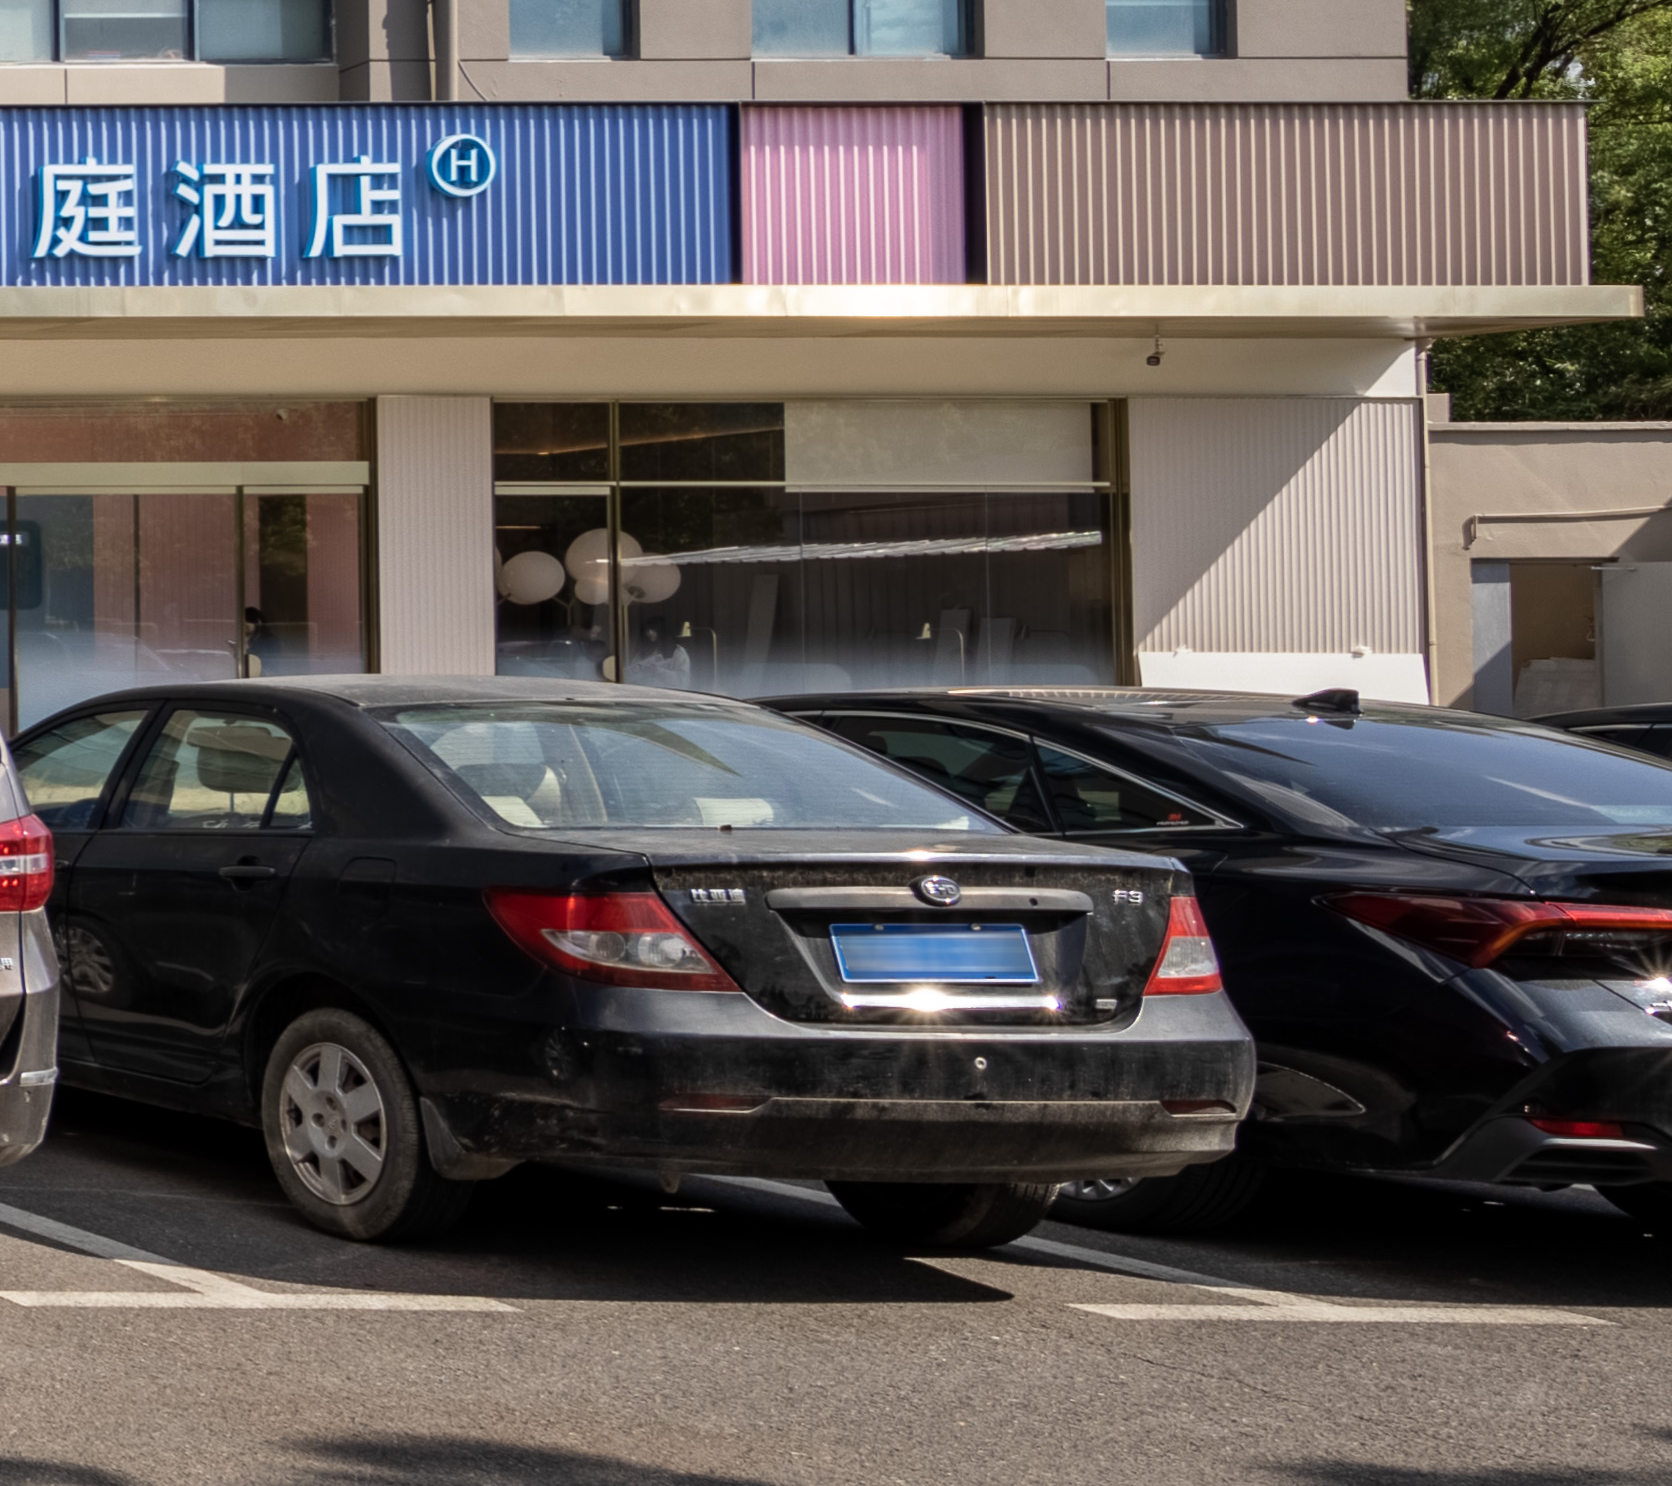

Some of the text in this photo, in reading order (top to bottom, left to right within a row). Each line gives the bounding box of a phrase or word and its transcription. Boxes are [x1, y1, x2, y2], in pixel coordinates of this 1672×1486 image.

[690, 888, 746, 904] 比亚迪
[1112, 889, 1144, 905] F3
